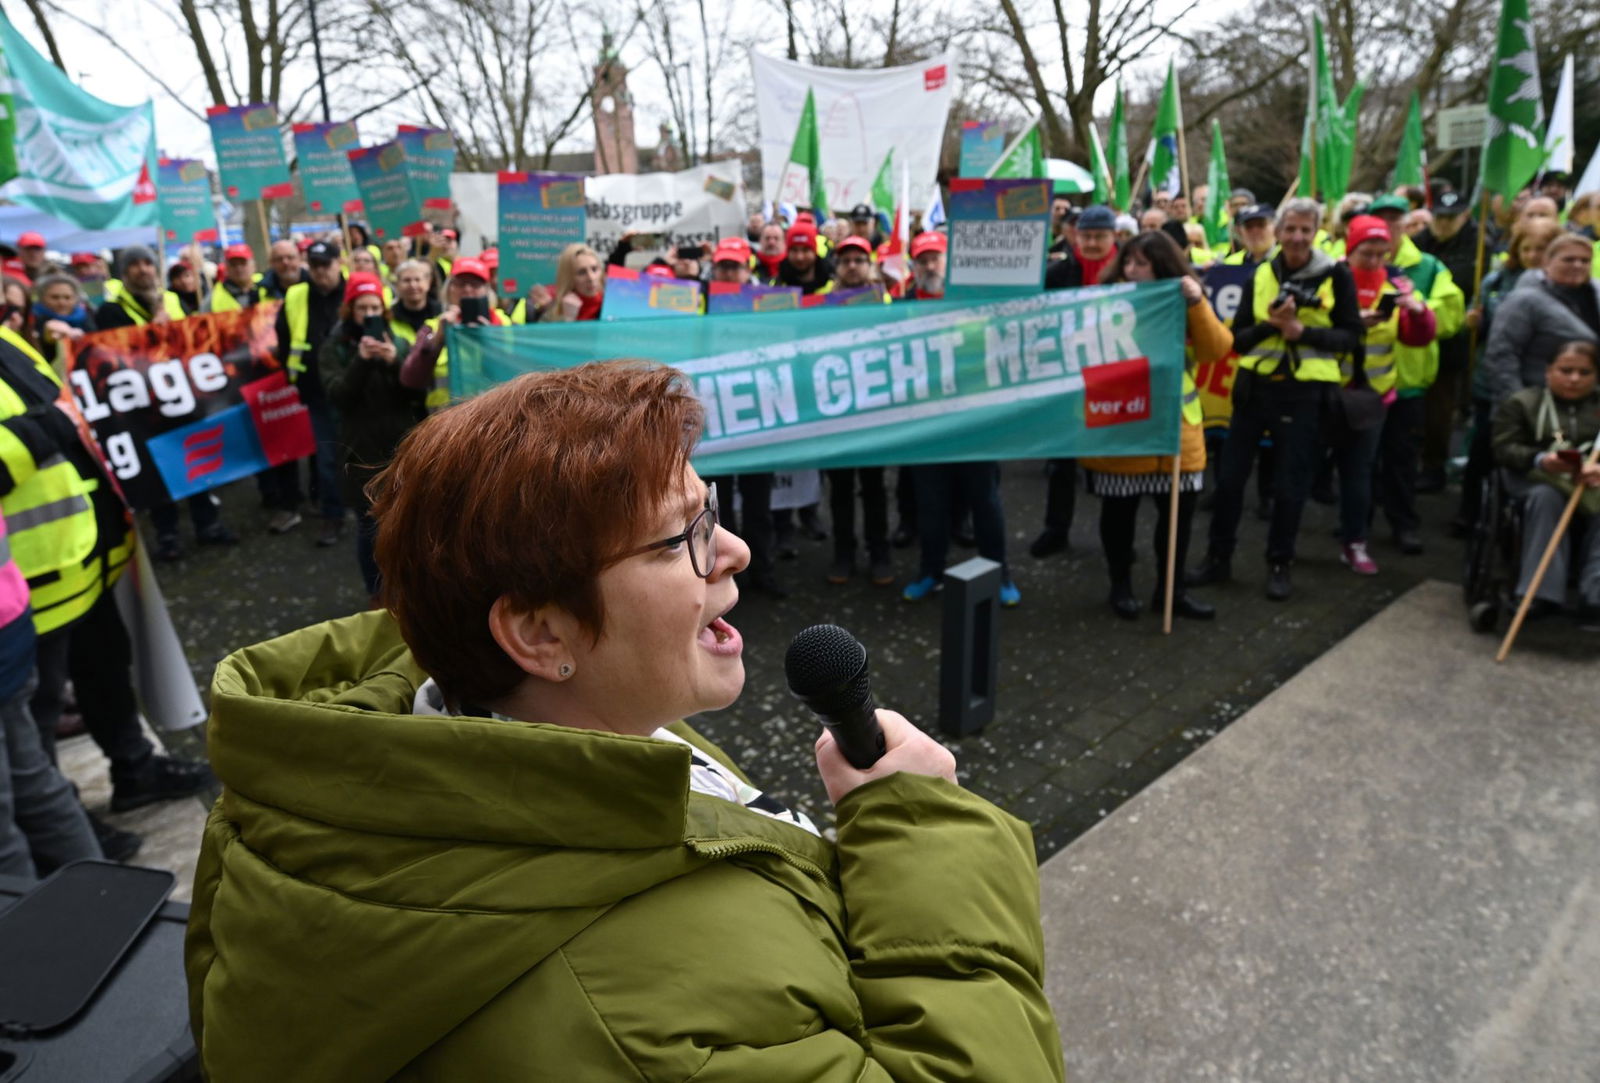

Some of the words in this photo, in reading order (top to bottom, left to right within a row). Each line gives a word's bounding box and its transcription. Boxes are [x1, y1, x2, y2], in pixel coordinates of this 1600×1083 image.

[71, 352, 229, 422] lage
[811, 330, 965, 416] GEHT
[984, 299, 1142, 388] MEHR
